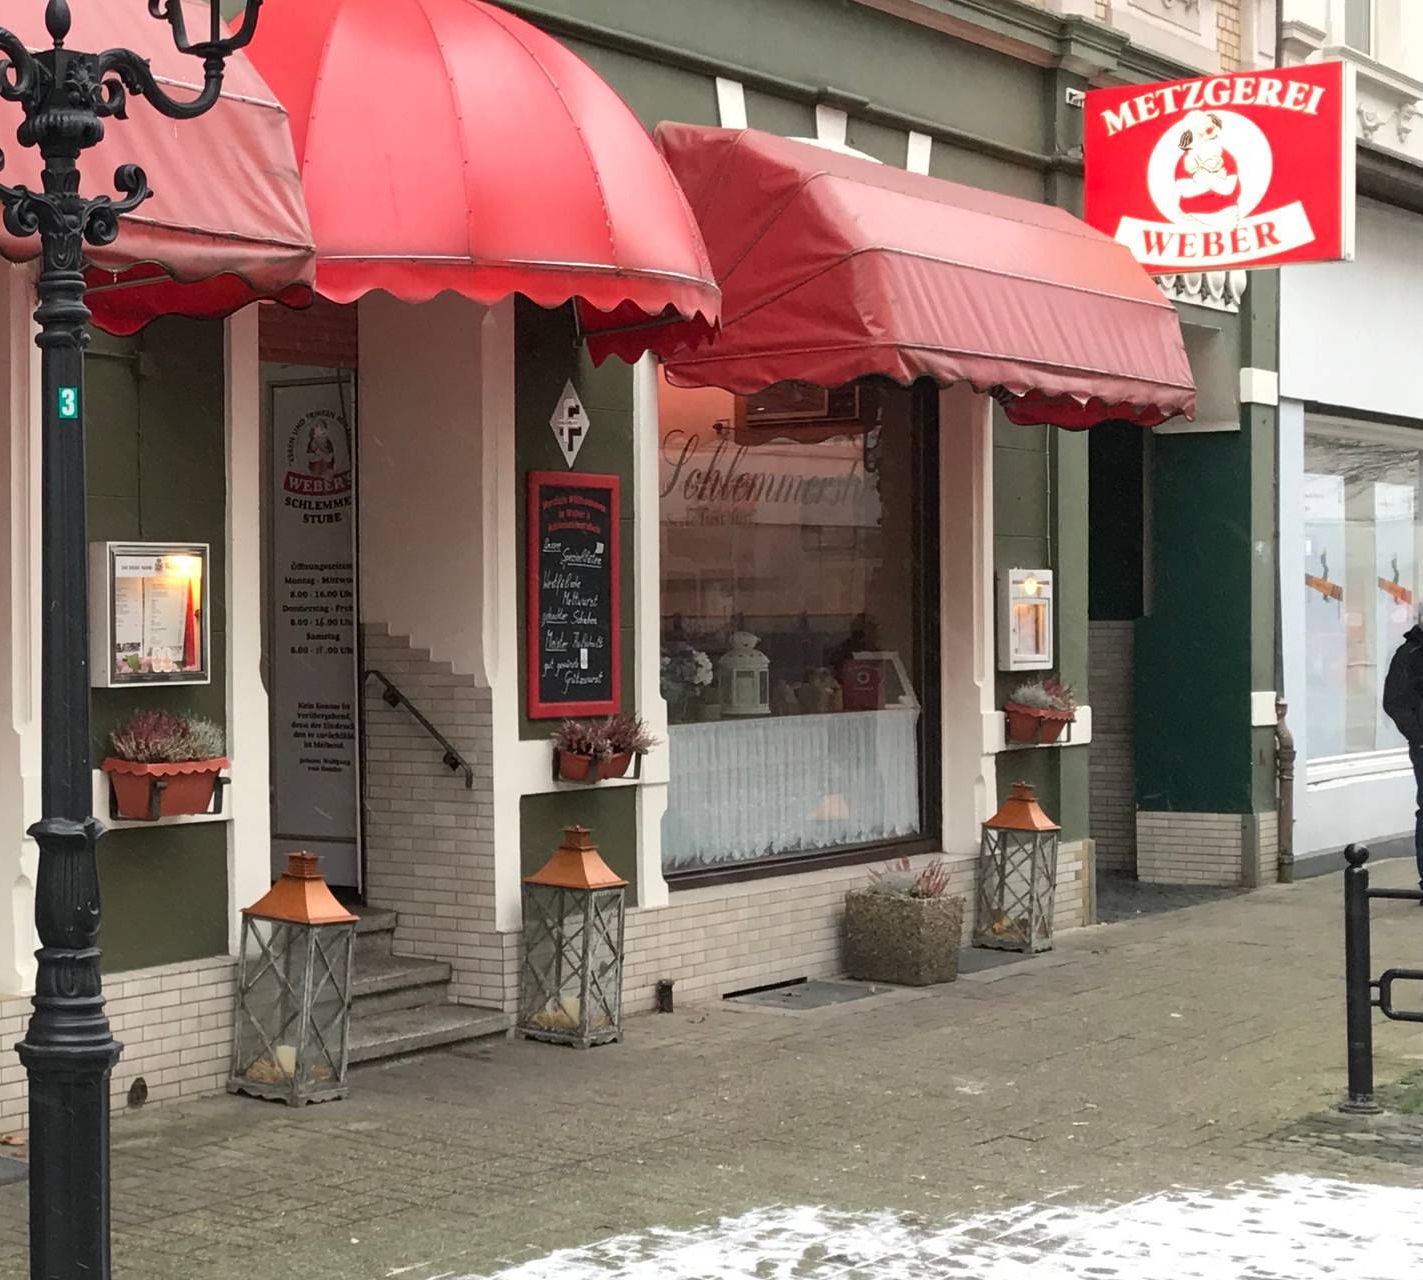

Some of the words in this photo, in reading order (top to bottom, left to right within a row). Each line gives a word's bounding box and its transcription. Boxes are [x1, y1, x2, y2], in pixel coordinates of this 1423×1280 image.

[1100, 77, 1326, 137] METZGEREI
[1143, 221, 1281, 259] WEBER
[61, 388, 75, 416] 3
[284, 496, 353, 511] SCHLEMME
[303, 513, 343, 524] STUBE
